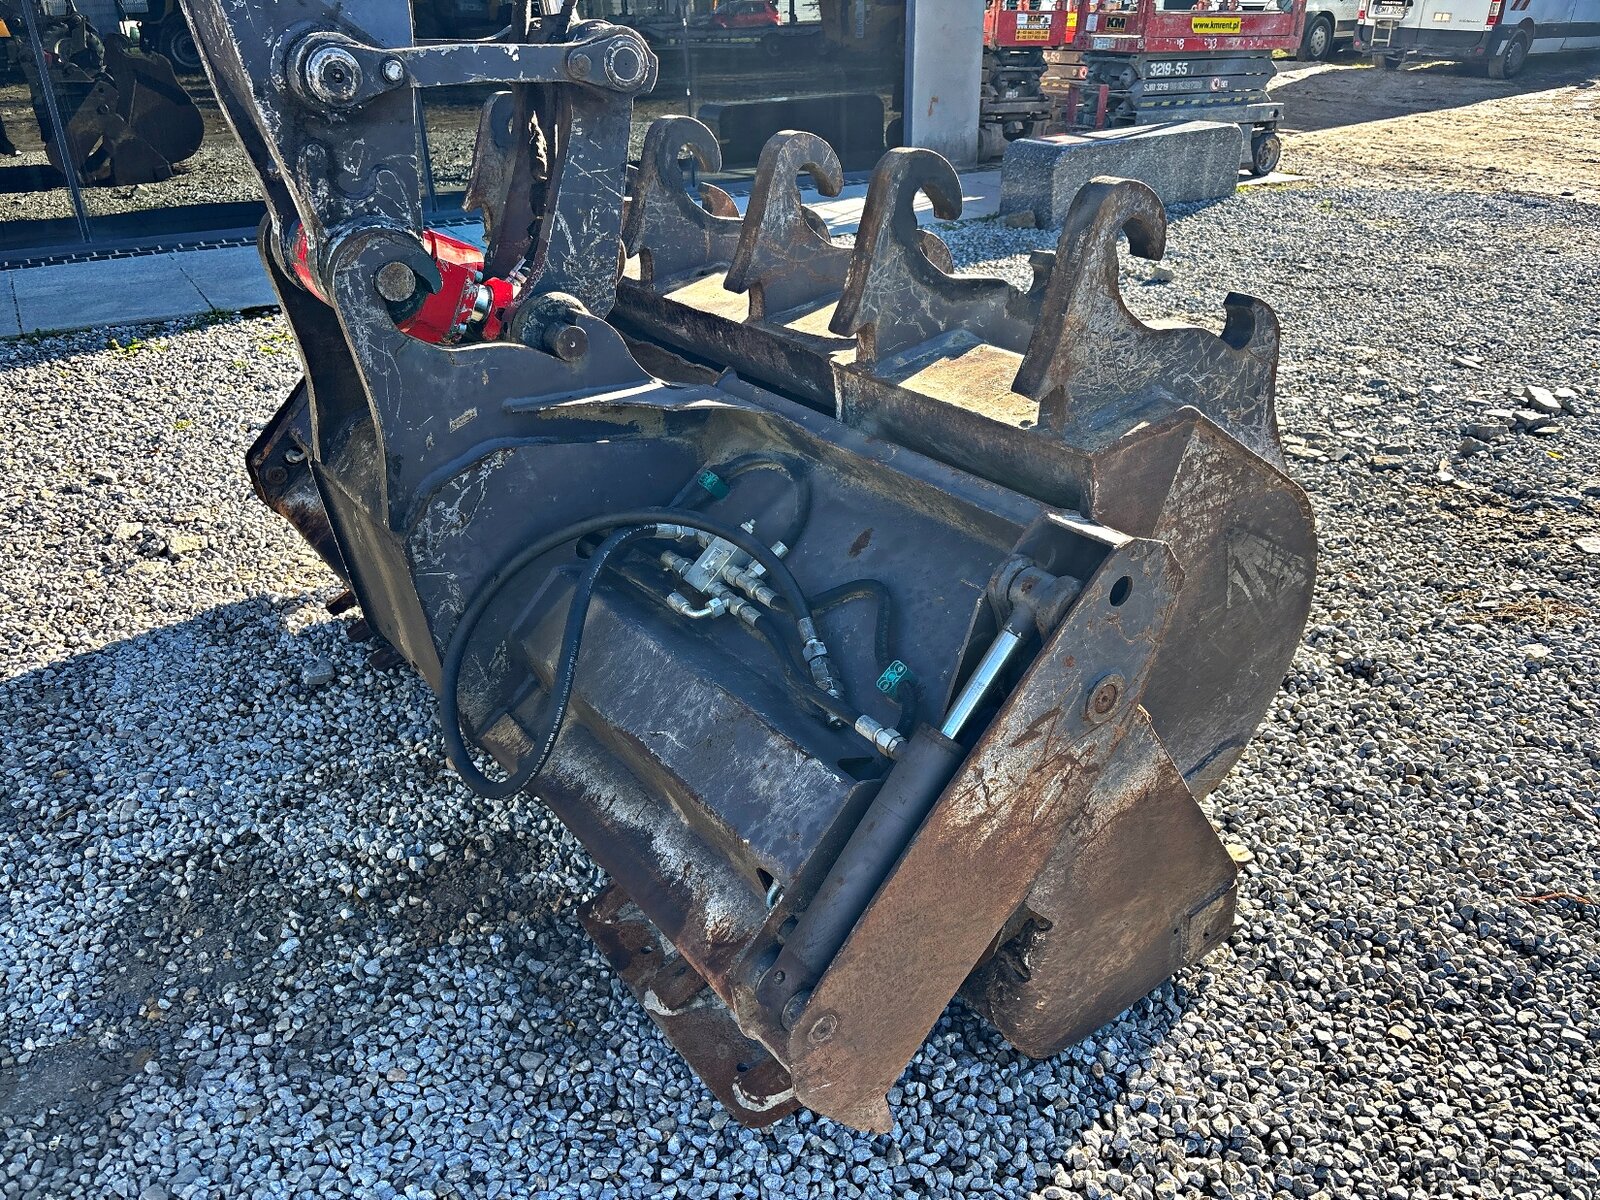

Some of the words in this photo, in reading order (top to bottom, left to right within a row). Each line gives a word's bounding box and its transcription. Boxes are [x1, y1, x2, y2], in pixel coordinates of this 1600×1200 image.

[1106, 17, 1126, 29] KM
[1193, 21, 1240, 31] www.kmrent.pl
[1149, 62, 1189, 76] 3219-55
